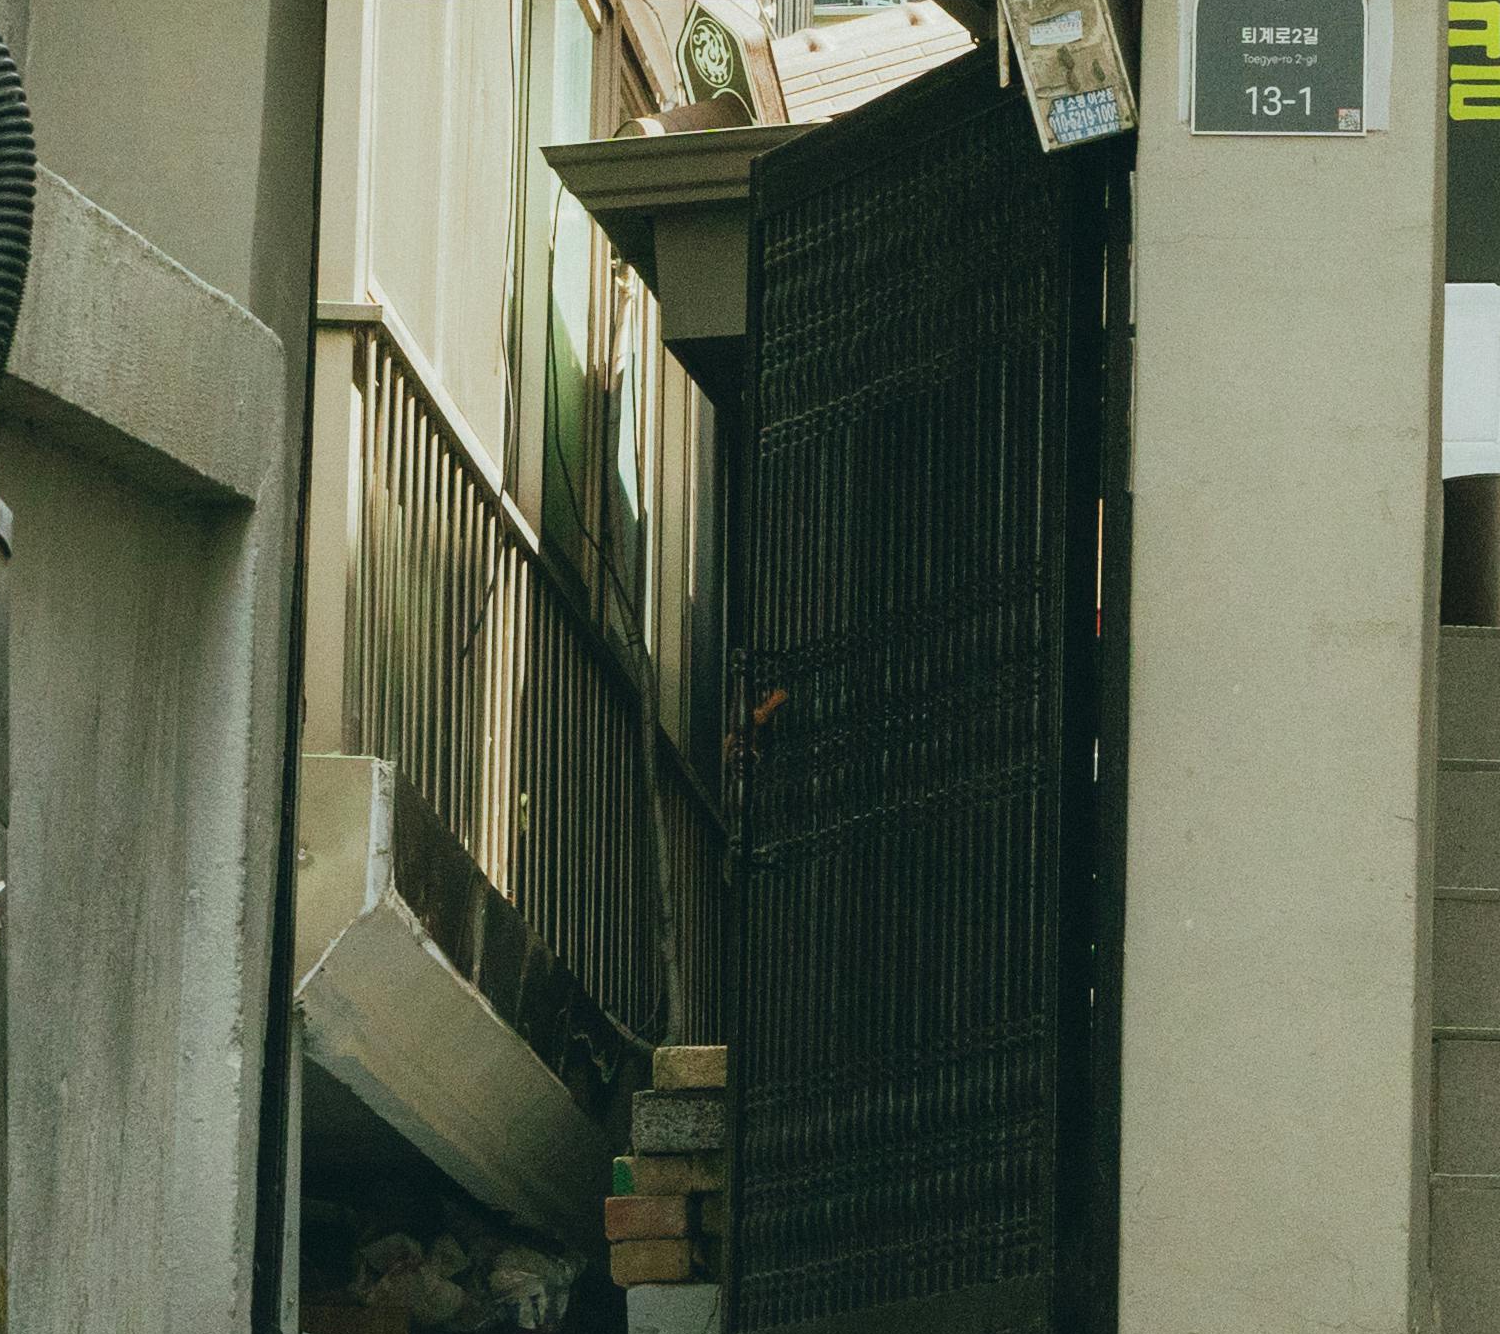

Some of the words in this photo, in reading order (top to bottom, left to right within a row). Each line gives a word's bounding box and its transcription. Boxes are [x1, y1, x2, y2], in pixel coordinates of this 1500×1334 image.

[1241, 26, 1319, 45] 퇴계로2길
[1243, 53, 1293, 67] Toegye-ro
[1295, 53, 1318, 67] 2-gil
[1245, 86, 1311, 116] 13-1
